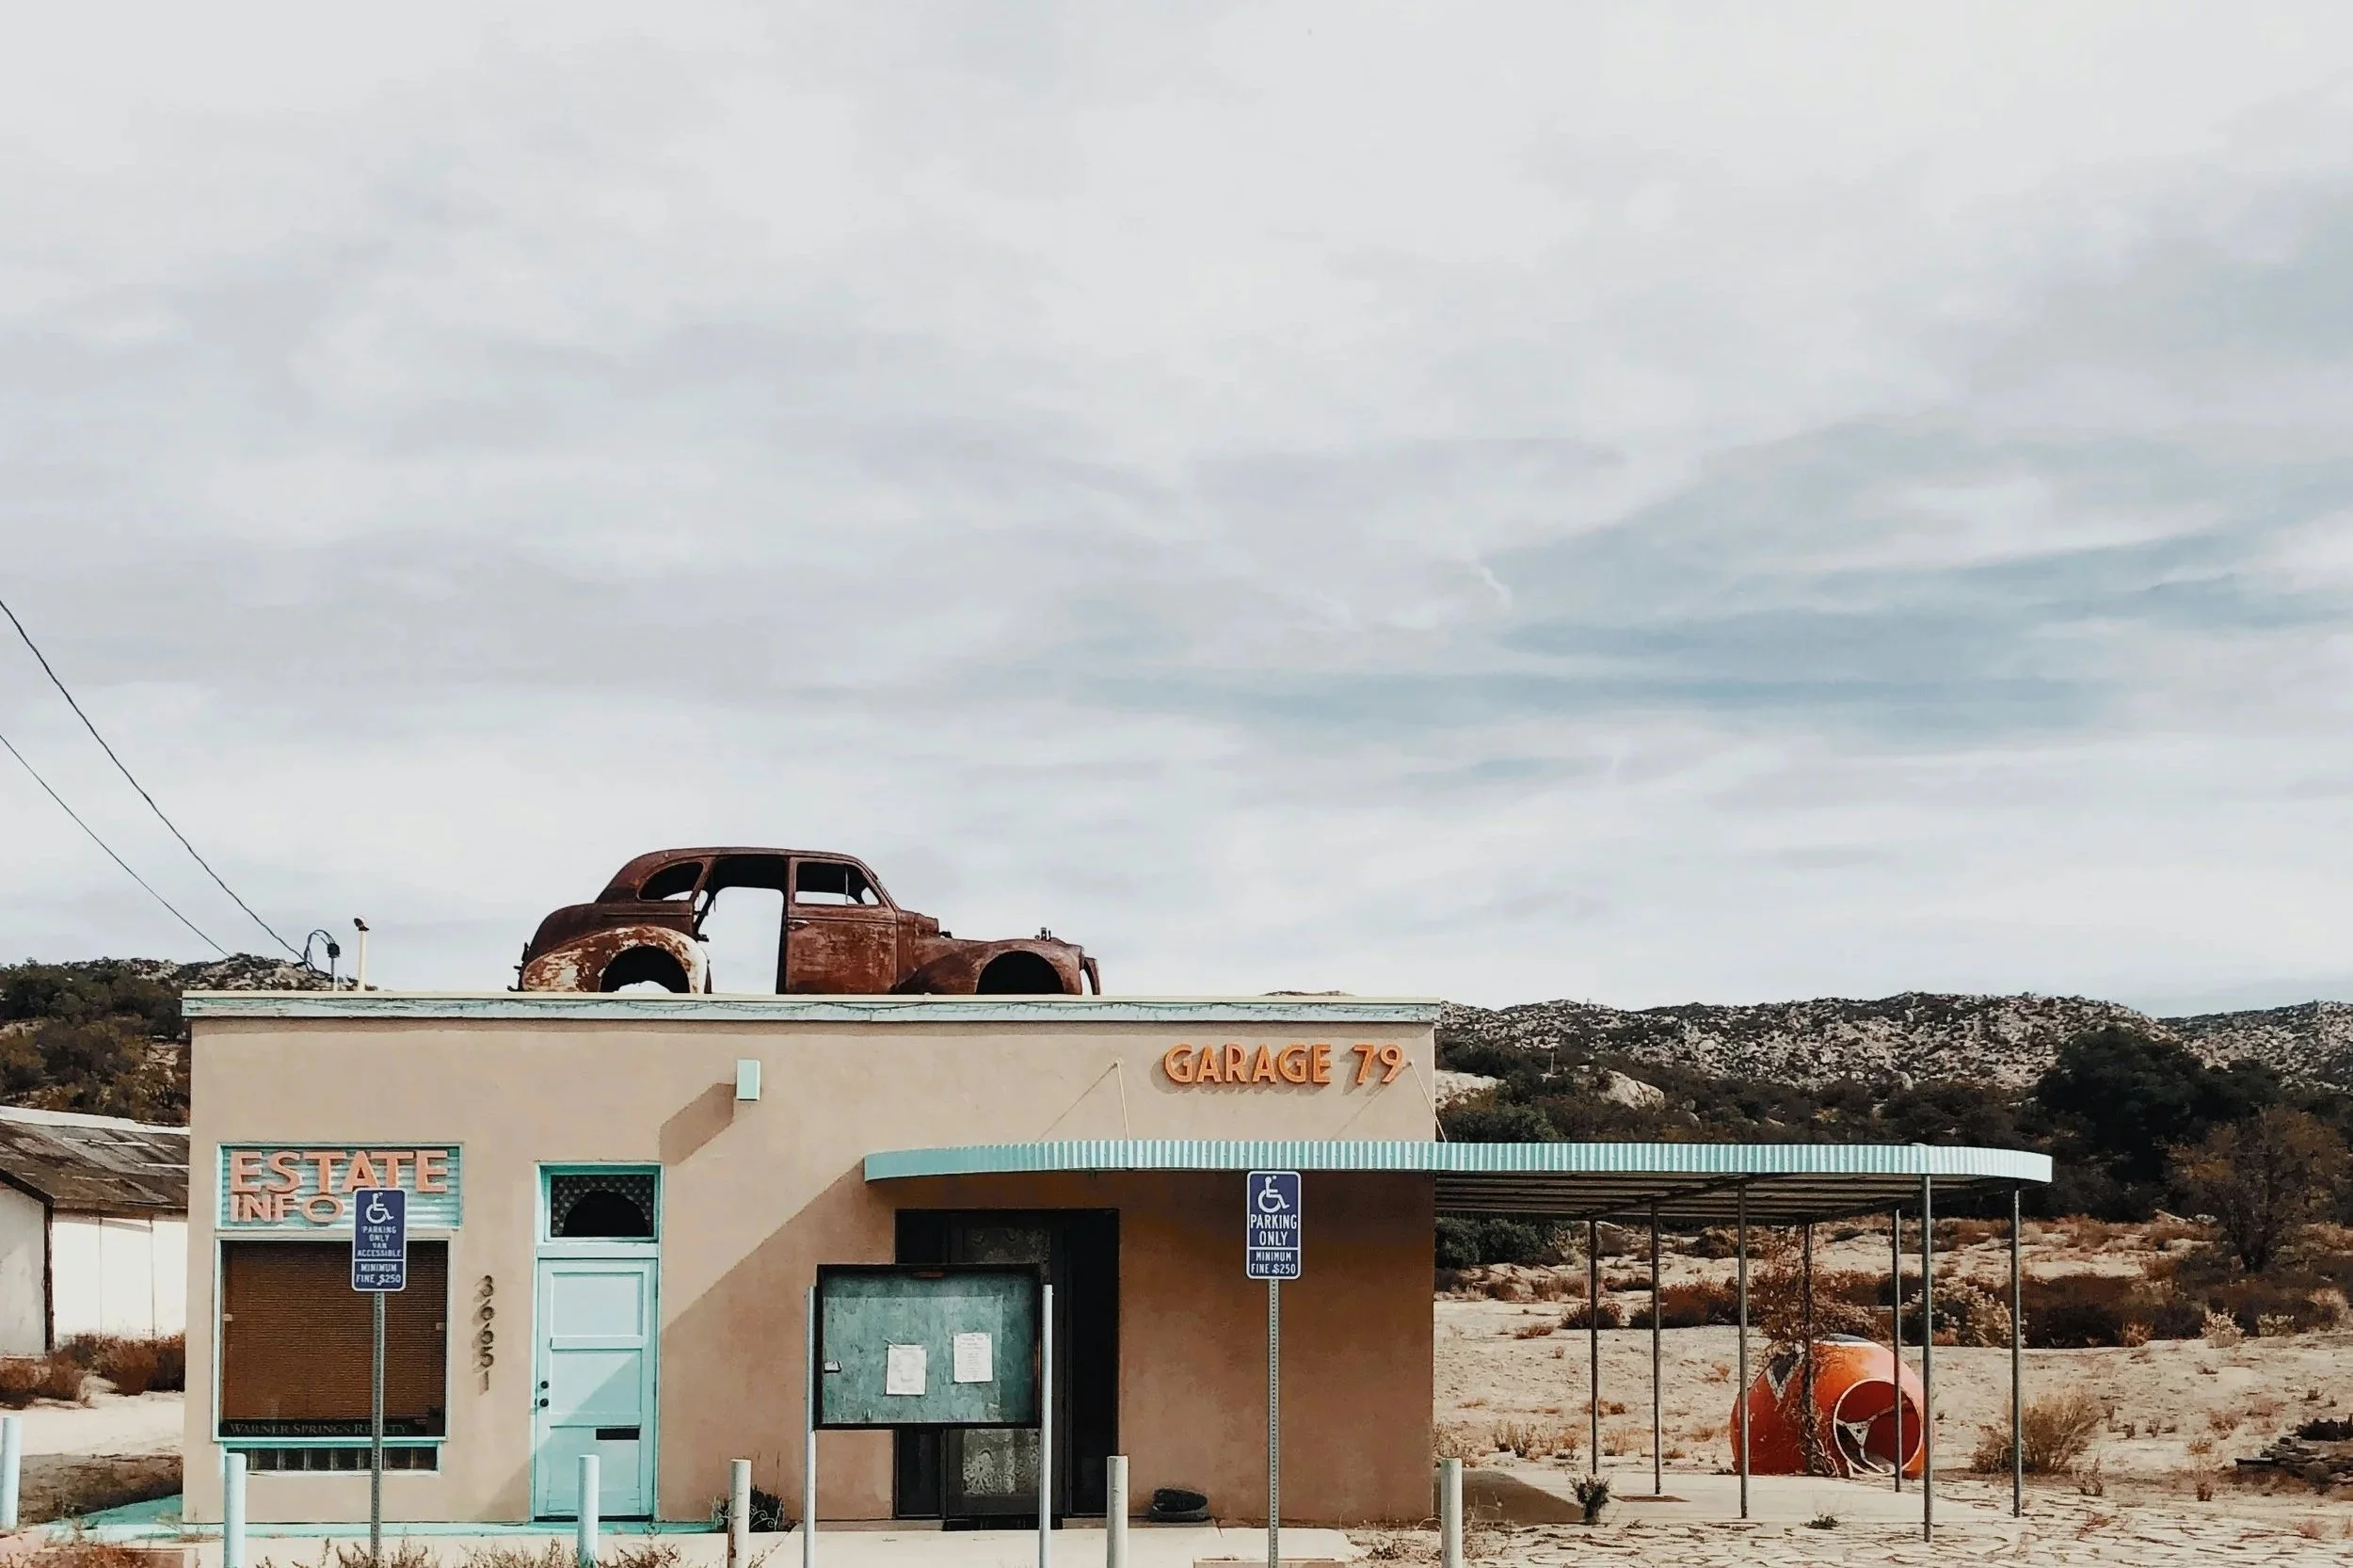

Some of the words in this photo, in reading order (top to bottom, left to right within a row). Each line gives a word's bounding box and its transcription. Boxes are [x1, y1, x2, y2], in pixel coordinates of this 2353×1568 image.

[1163, 1043, 1333, 1084] GARAGE
[1352, 1043, 1405, 1085] 79
[229, 1149, 449, 1194] ESTATE
[229, 1192, 345, 1224] INFO
[1250, 1213, 1298, 1229] PARKING
[361, 1225, 397, 1234] PARKING
[369, 1234, 390, 1242] ONLY
[1258, 1230, 1289, 1246] ONLY
[357, 1249, 402, 1257] ACCESSIBLE
[1256, 1251, 1292, 1262] MINIMUM
[360, 1263, 397, 1272] MINIMUM
[1250, 1263, 1270, 1274] FINE
[1272, 1263, 1296, 1274] $250
[356, 1273, 375, 1284] FINE
[379, 1273, 402, 1284] $250
[479, 1274, 494, 1392] 36651
[230, 1423, 290, 1434] WARNER
[294, 1423, 351, 1434] SPRINGS
[354, 1423, 408, 1434] RELTY
